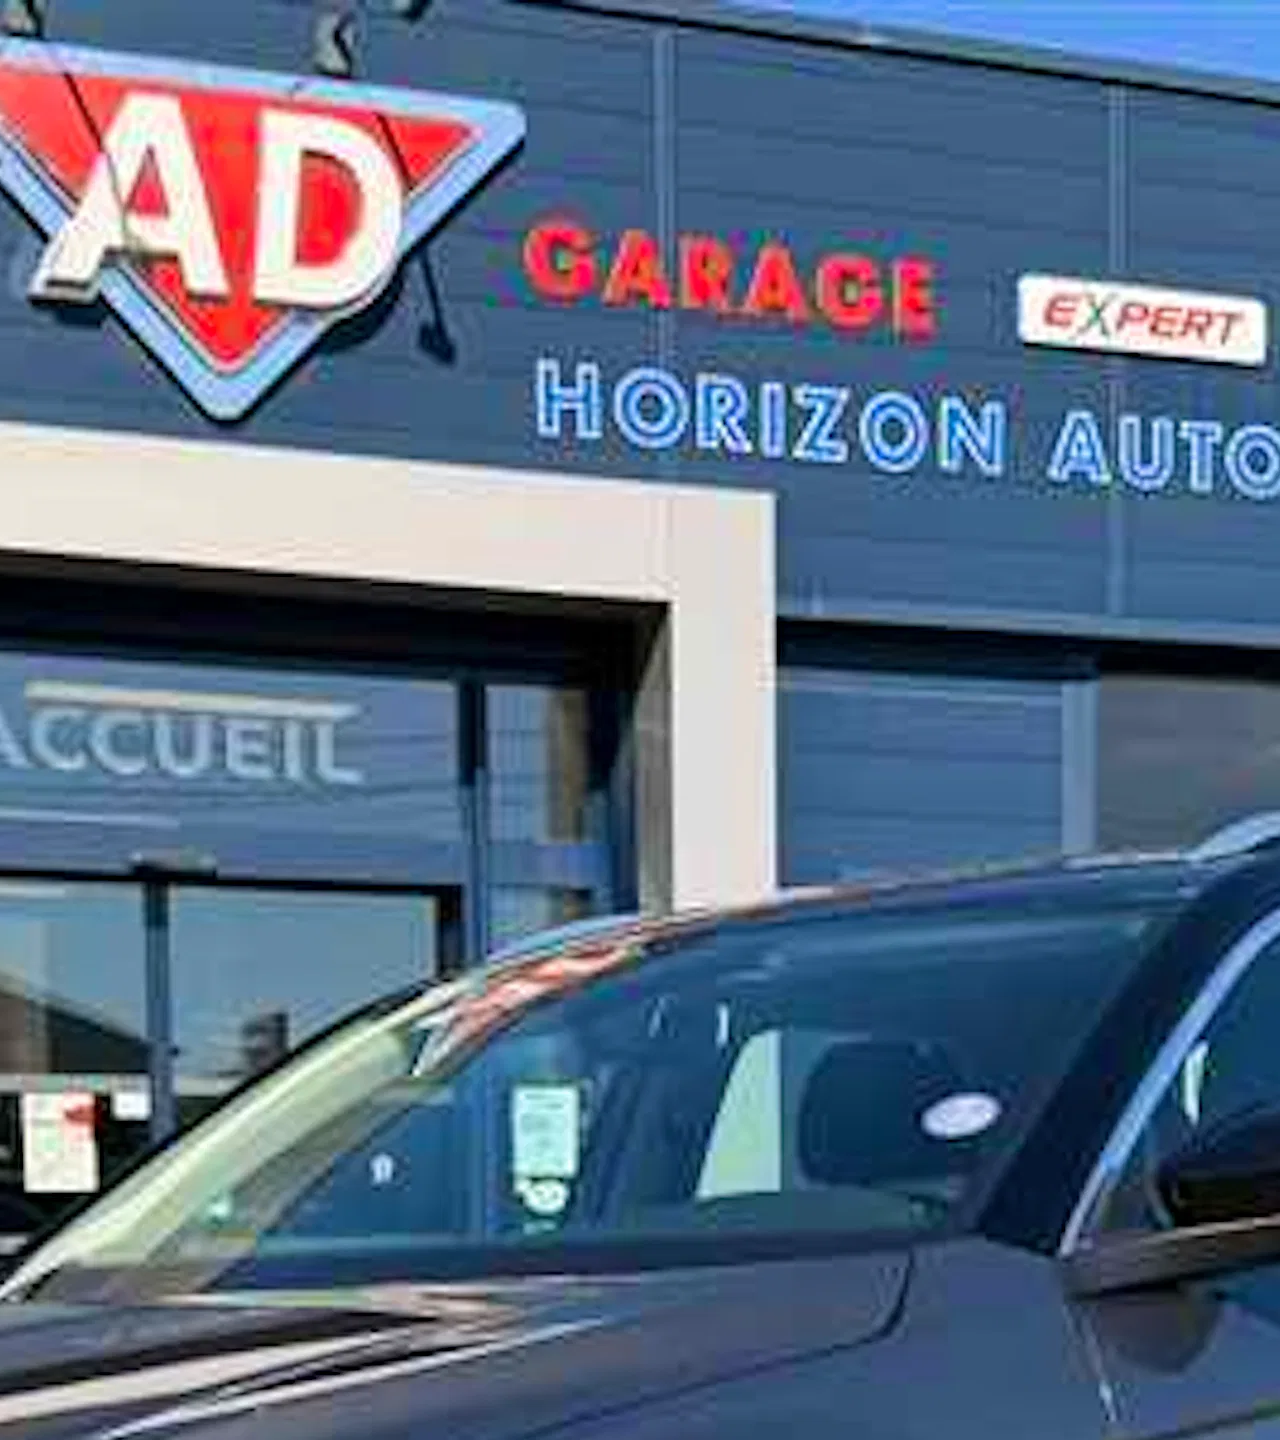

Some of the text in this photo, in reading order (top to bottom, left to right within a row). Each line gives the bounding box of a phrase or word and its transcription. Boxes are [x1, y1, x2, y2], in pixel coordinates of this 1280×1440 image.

[28, 91, 405, 309] AD
[524, 221, 937, 338] GARAGE
[1042, 293, 1246, 346] EXPERT
[535, 358, 1007, 474] HORIZON
